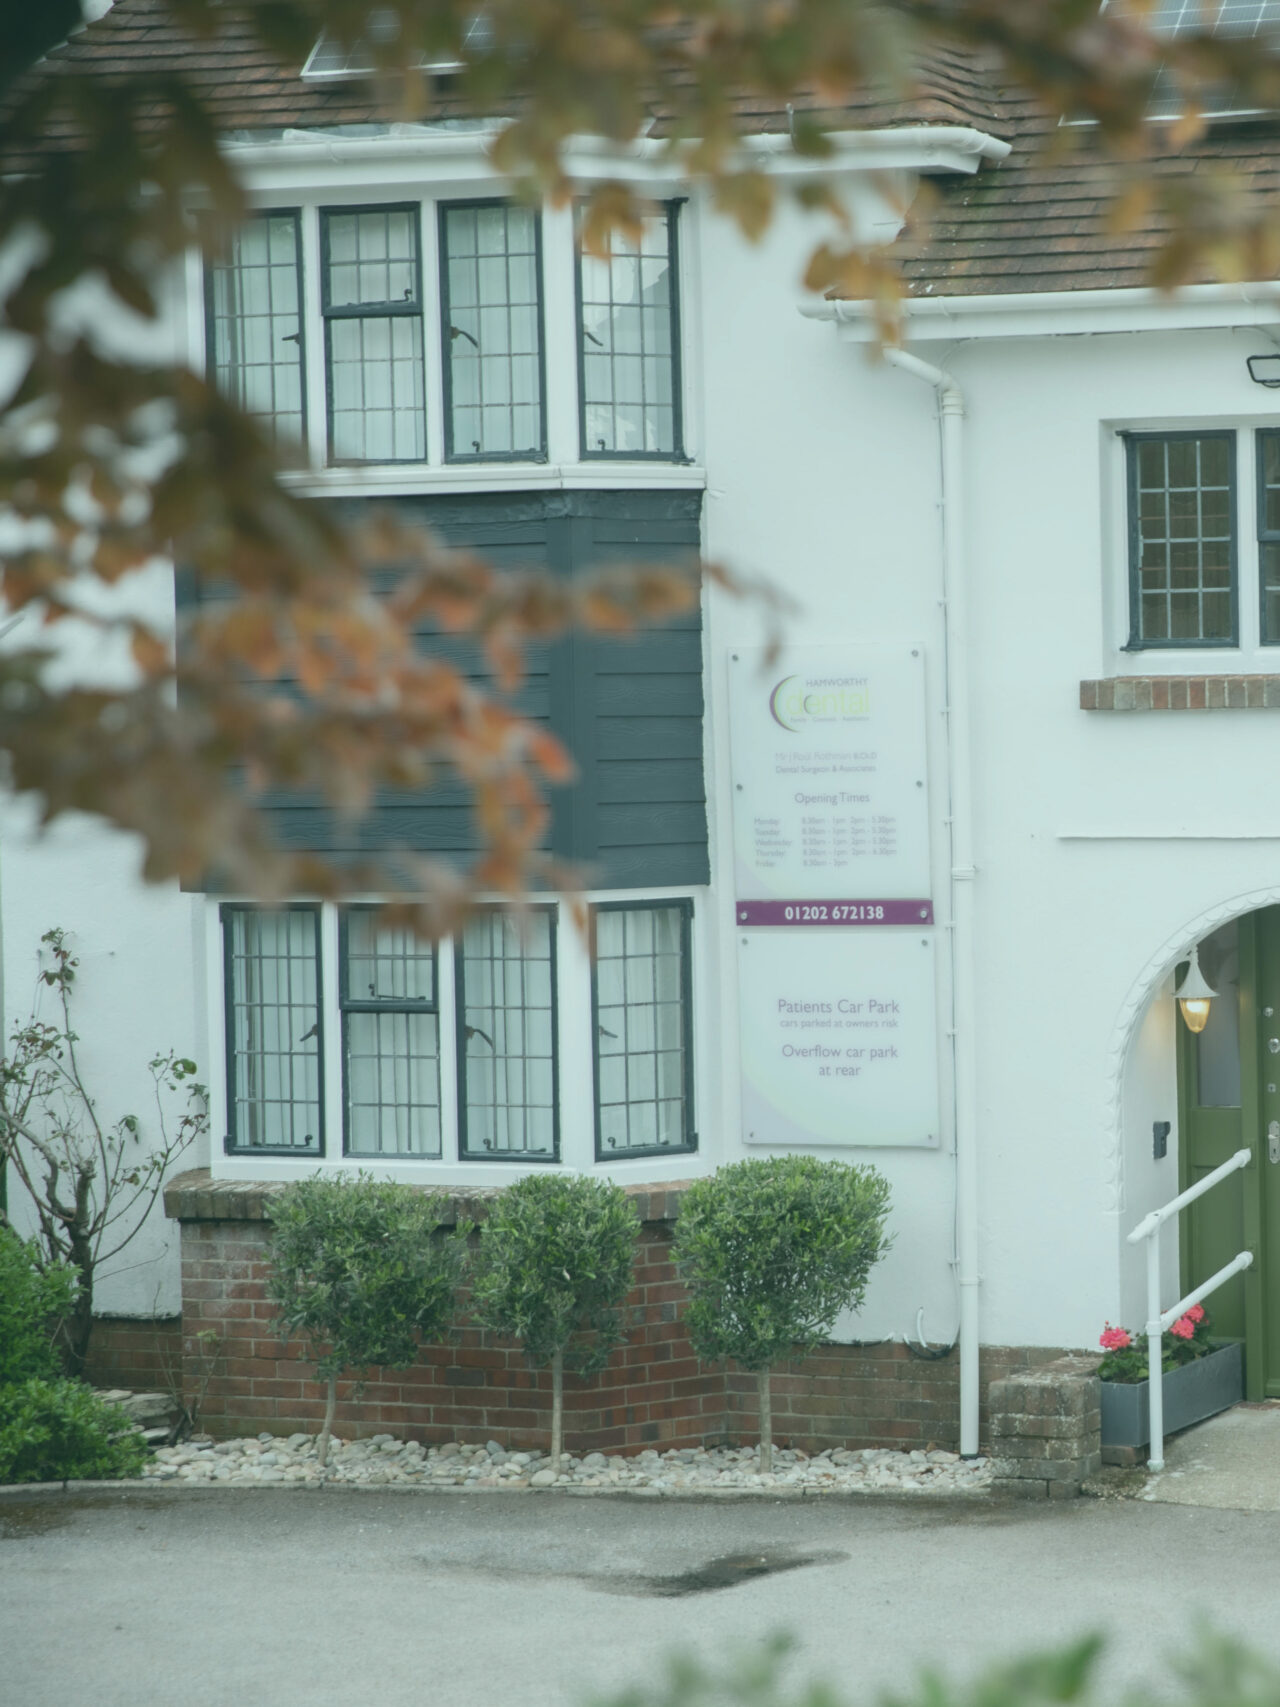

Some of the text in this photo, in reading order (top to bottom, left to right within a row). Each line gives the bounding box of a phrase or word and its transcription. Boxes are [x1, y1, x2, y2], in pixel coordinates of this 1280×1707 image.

[806, 678, 868, 687] HAMWORTHY
[786, 688, 870, 715] dental
[794, 791, 870, 806] Opening Times
[785, 905, 884, 920] 01202 672138
[778, 998, 900, 1014] Patients Car Park
[779, 1018, 899, 1030] cars parked at owners risk
[781, 1044, 898, 1062] Overflow car park
[818, 1067, 861, 1076] at rear
